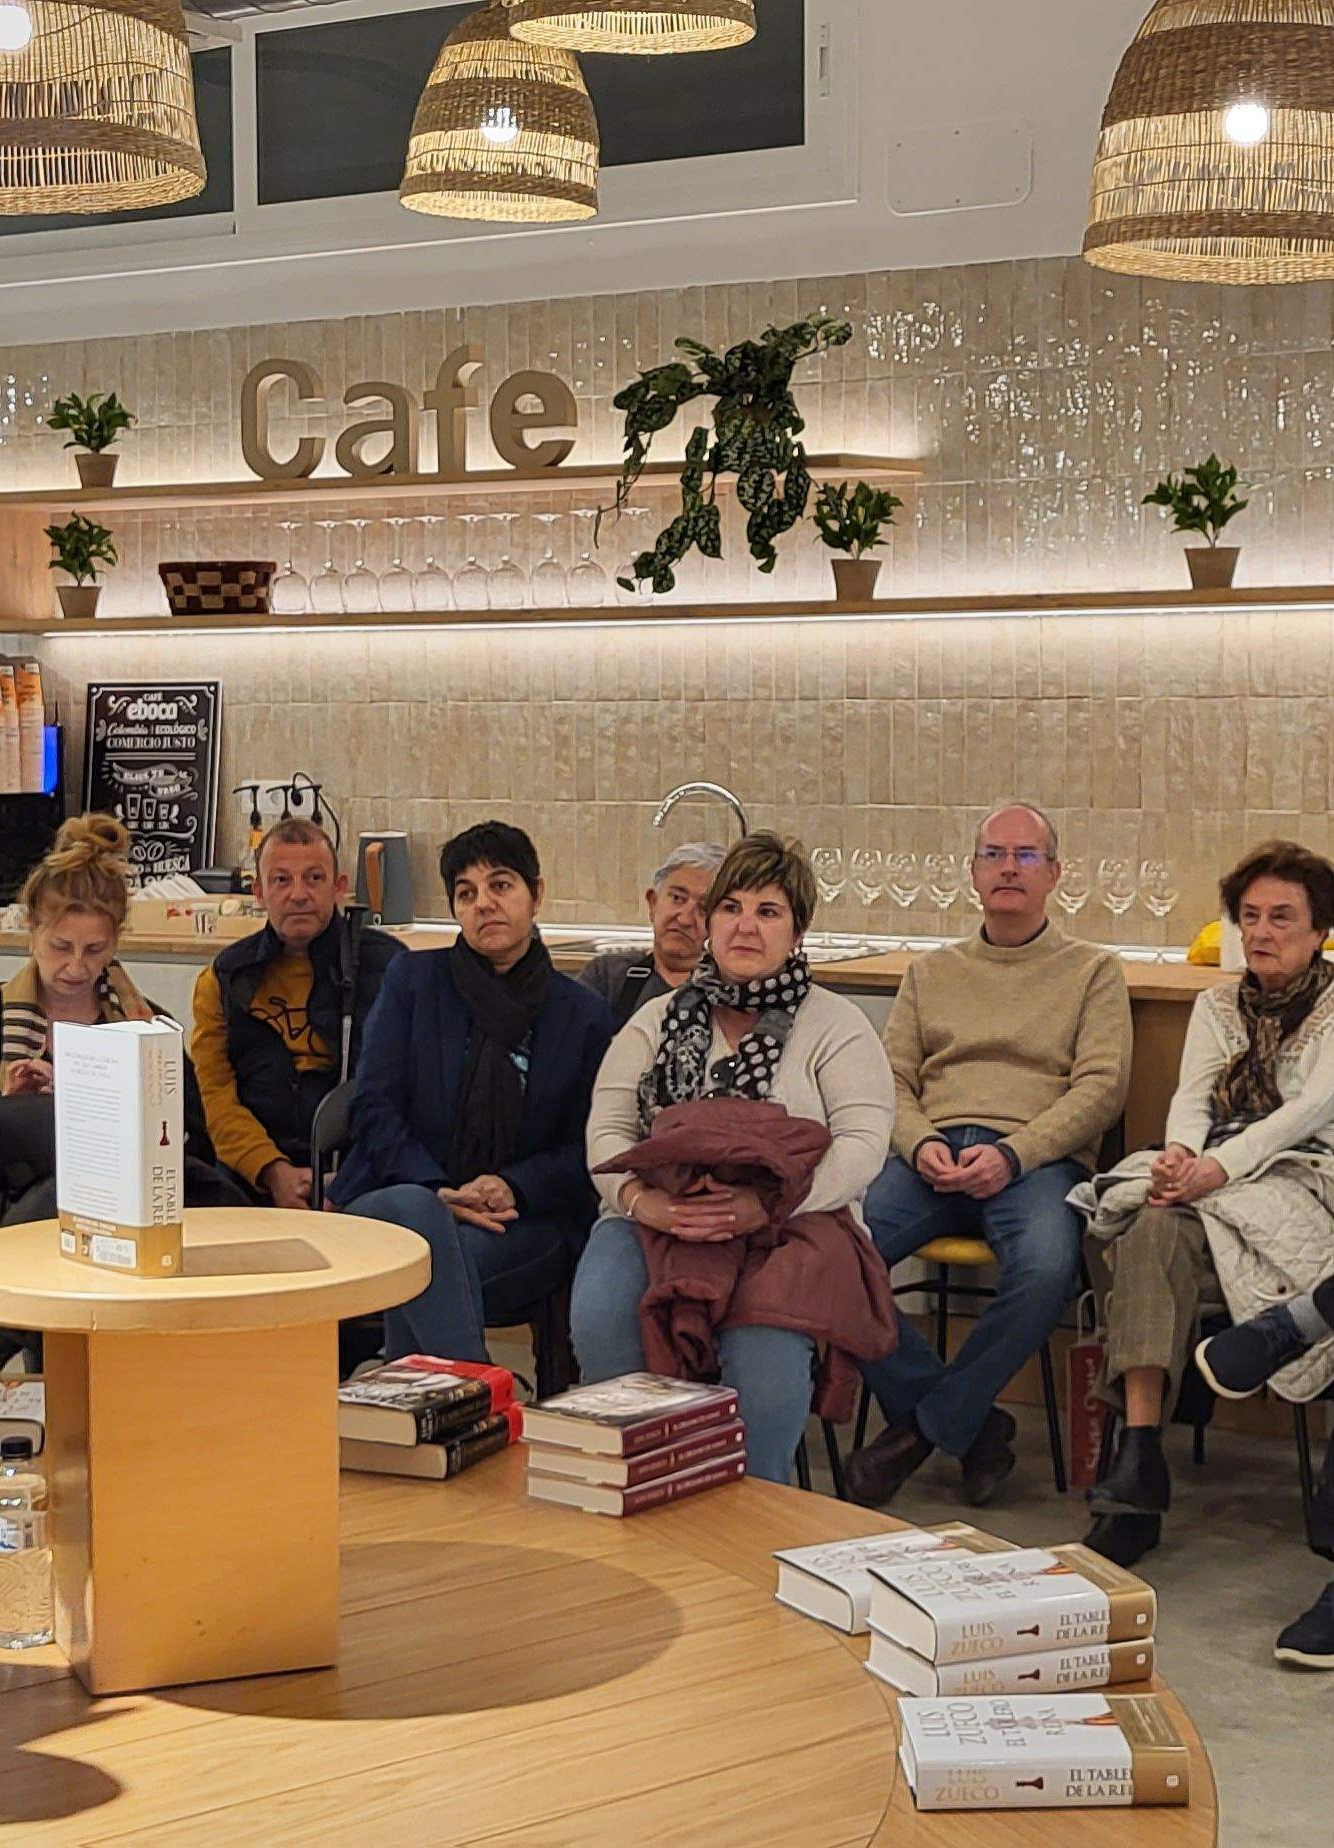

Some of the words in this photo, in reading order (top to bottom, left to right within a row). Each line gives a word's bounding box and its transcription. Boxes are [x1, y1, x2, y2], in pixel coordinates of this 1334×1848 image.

[240, 344, 578, 481] Cafe
[127, 698, 178, 720] eboca
[107, 737, 161, 749] COMERCIO
[162, 737, 196, 749] JUSTO
[153, 855, 190, 873] HUESCA
[164, 1060, 176, 1096] LUIS
[152, 1166, 164, 1182] DE
[152, 1186, 164, 1203] LA
[1060, 1614, 1072, 1626] EL
[961, 1622, 995, 1638] LUIS
[1060, 1657, 1072, 1670] EL
[1069, 1768, 1085, 1782] EL
[935, 1785, 999, 1802] ZUECO
[1066, 1784, 1084, 1797] DE
[1087, 1784, 1105, 1796] LA
